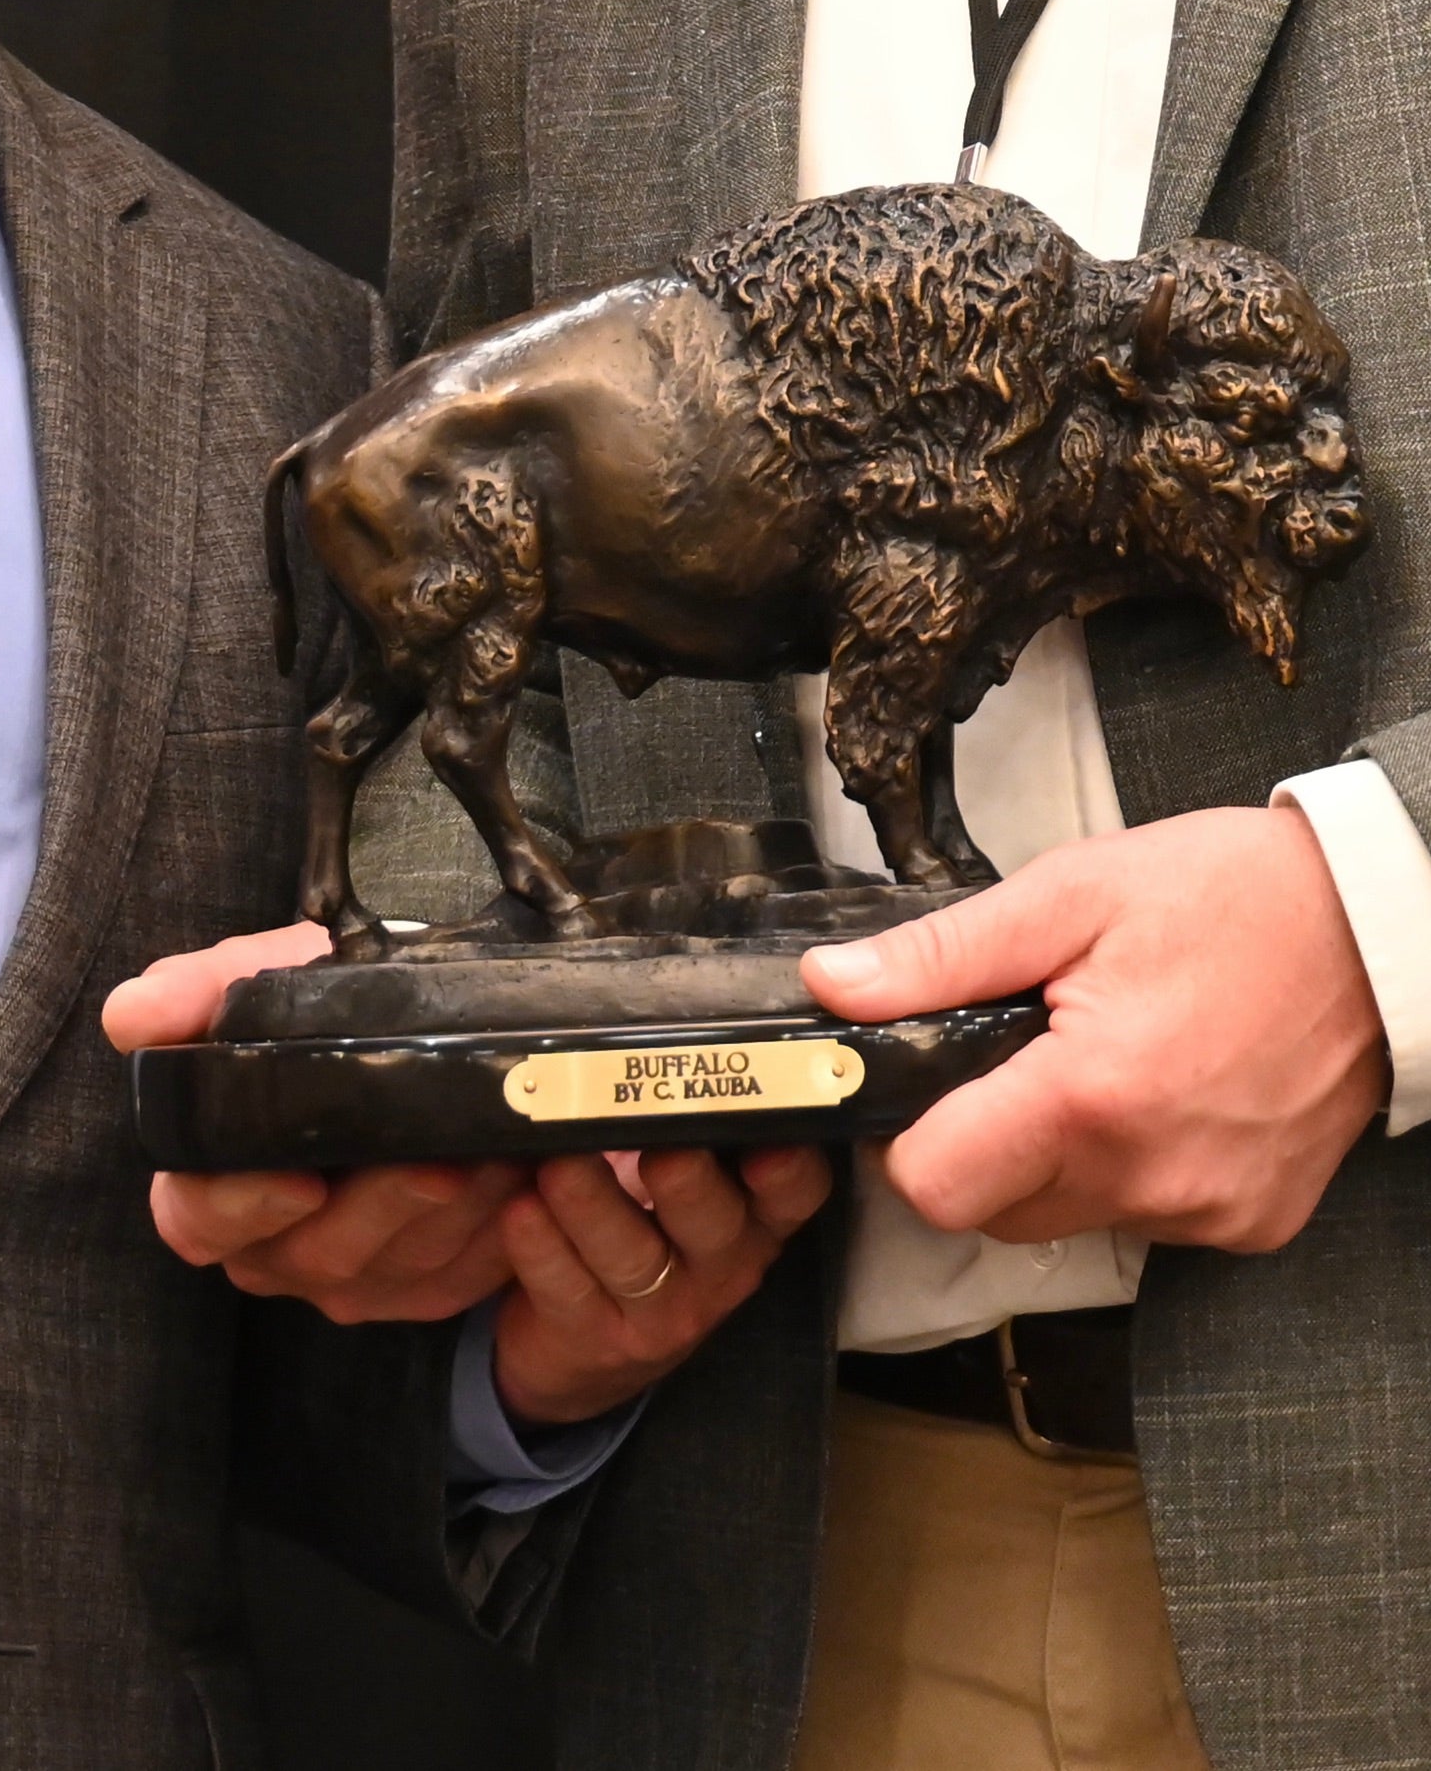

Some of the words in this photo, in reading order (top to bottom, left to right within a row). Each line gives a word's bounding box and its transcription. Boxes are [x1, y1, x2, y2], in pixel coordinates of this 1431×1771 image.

[624, 1051, 750, 1080] BUFFALO
[614, 1081, 644, 1103] BY
[653, 1080, 675, 1100] C.
[683, 1075, 763, 1100] KAUBA
